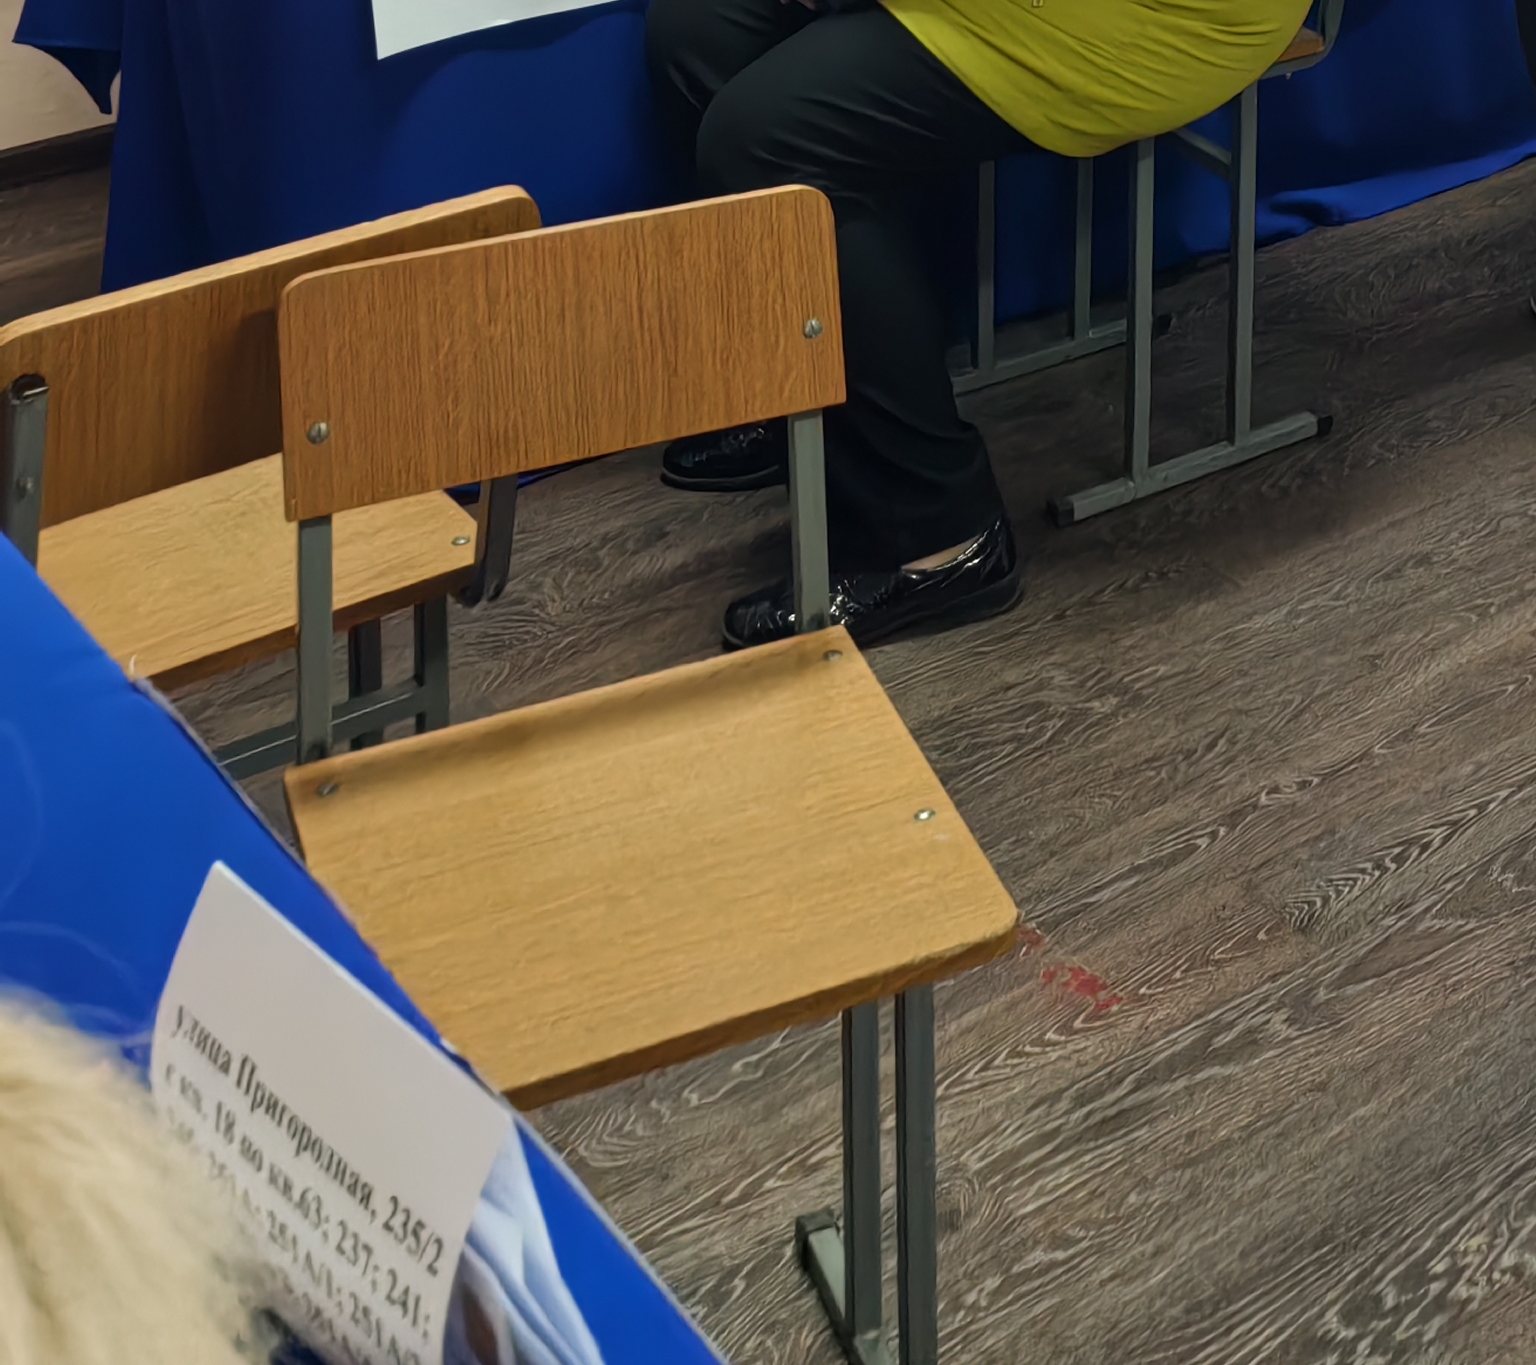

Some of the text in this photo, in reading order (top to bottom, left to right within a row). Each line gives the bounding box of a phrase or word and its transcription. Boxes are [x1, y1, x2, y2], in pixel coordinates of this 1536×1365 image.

[171, 1004, 232, 1077] улица
[236, 1054, 377, 1224] Пригородная,
[382, 1195, 443, 1278] 235/2
[336, 1219, 380, 1295] 237;
[385, 1268, 431, 1339] 241;
